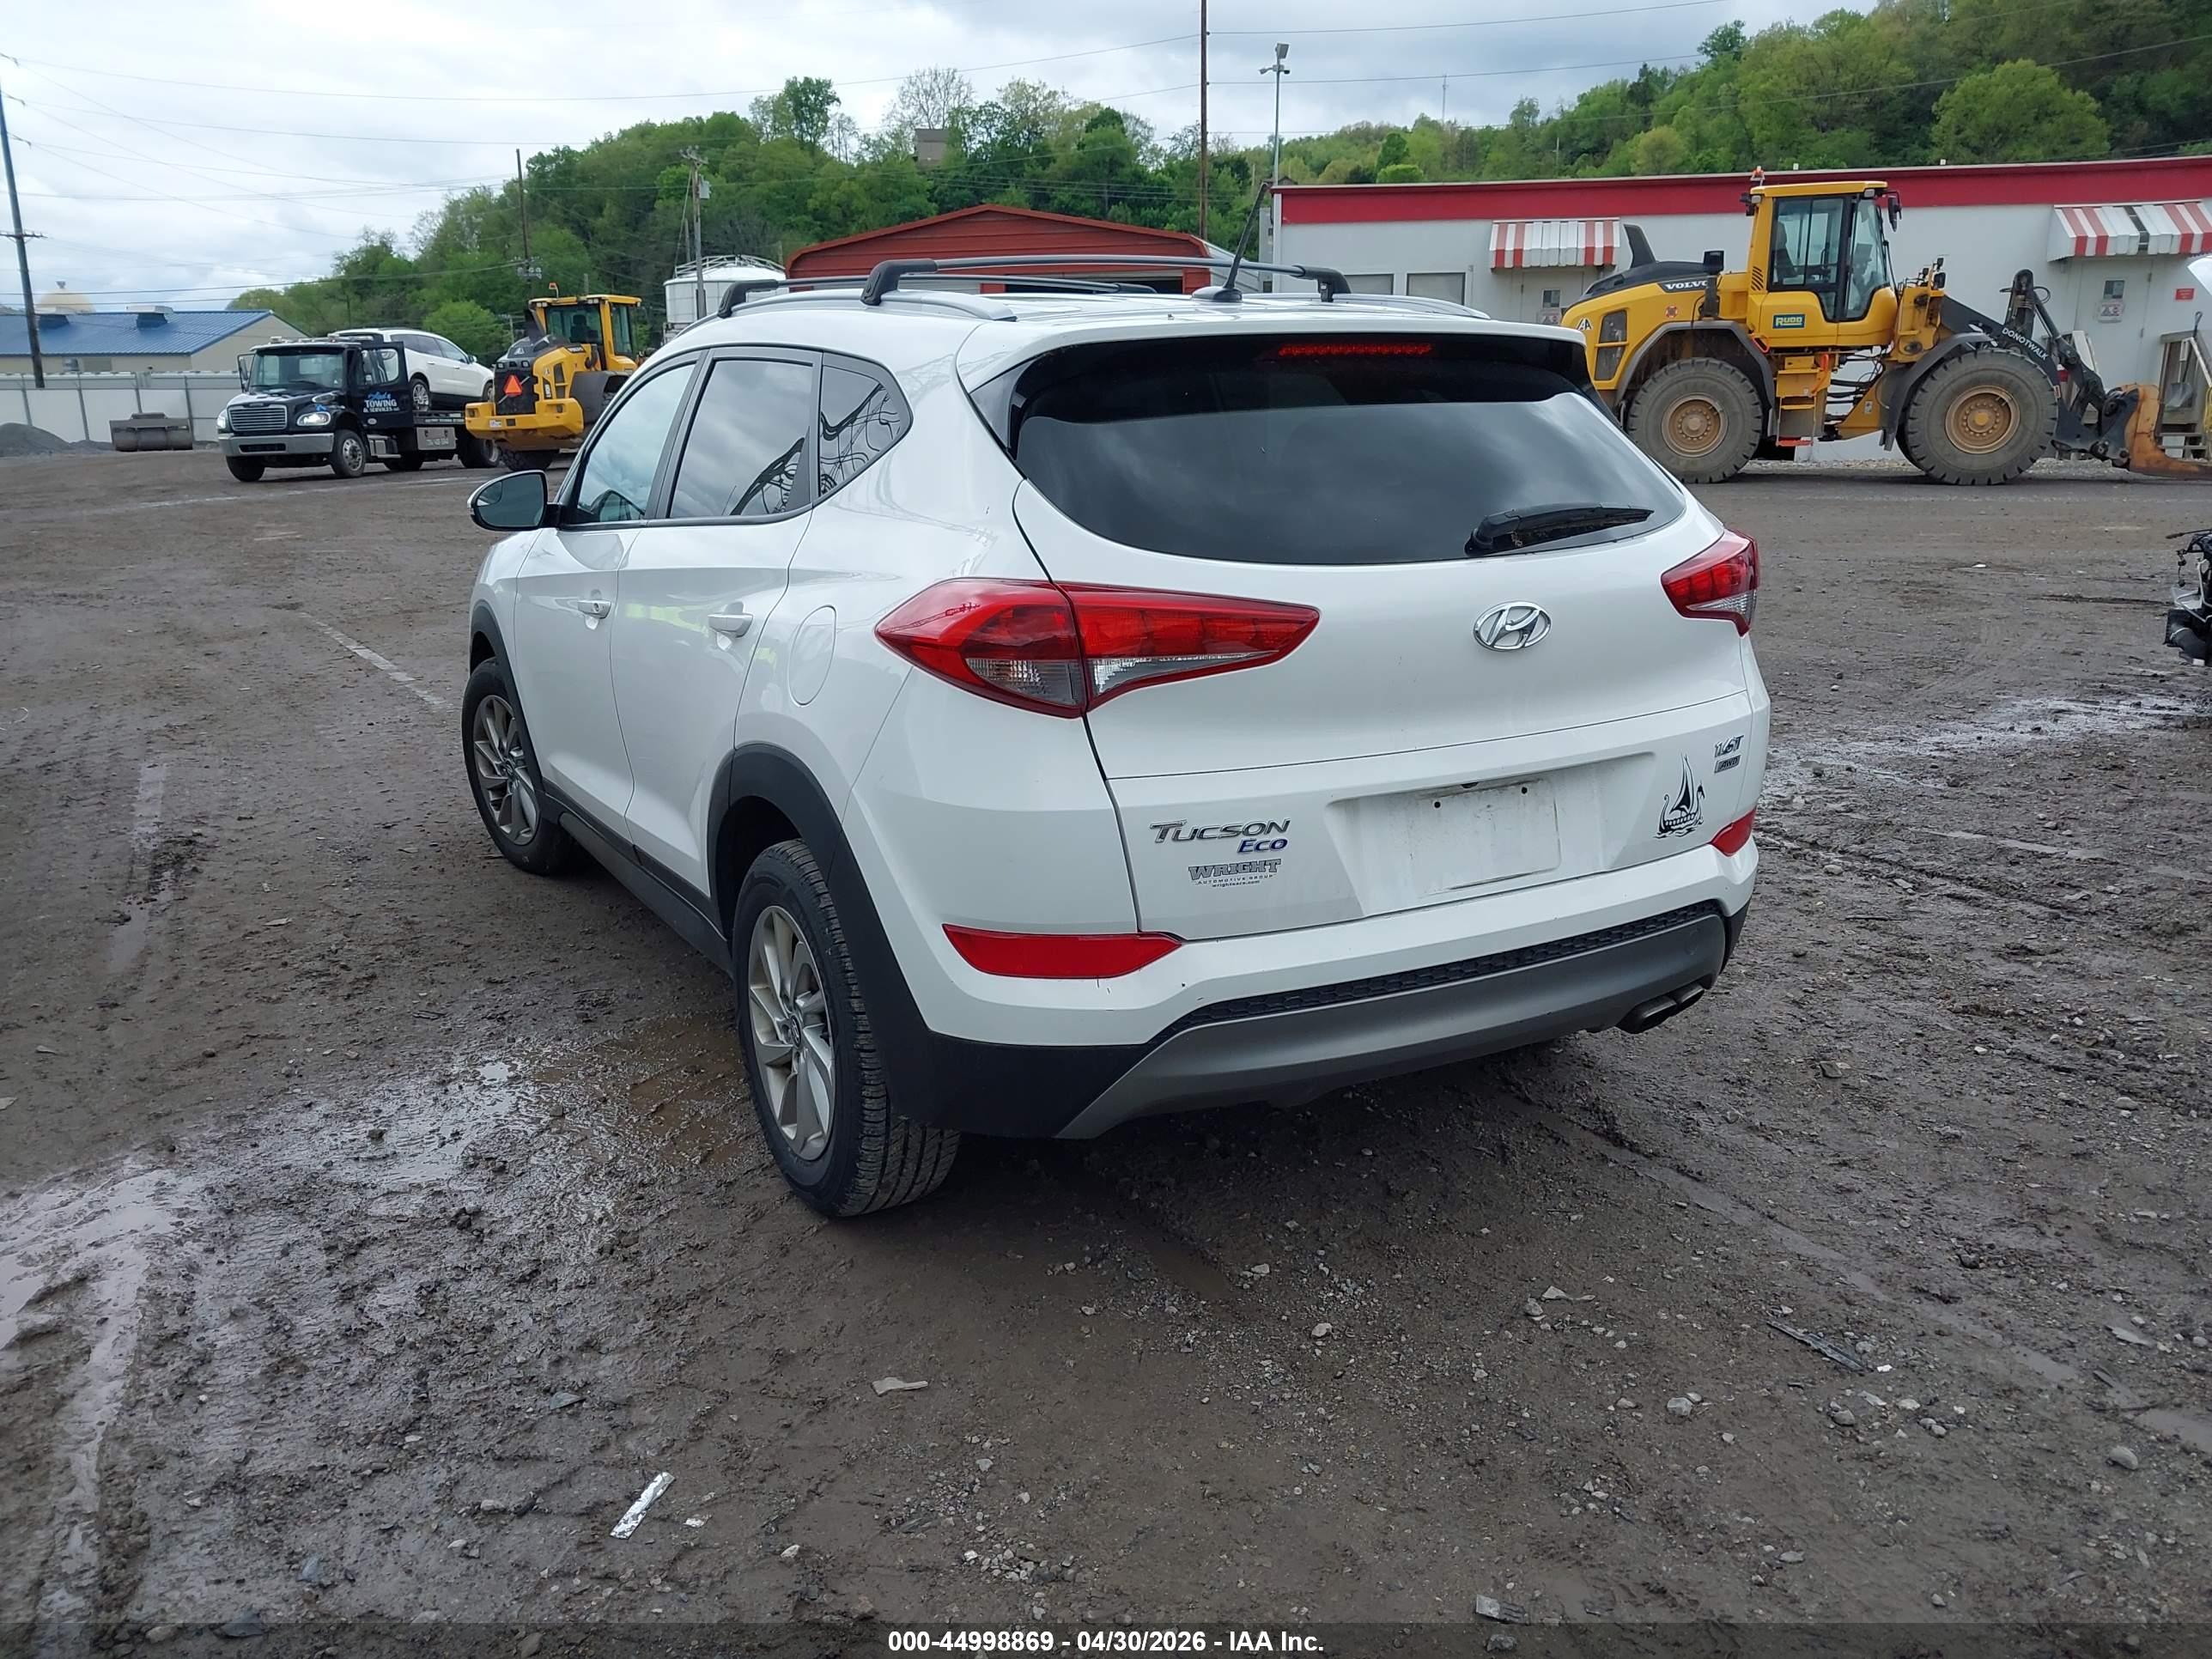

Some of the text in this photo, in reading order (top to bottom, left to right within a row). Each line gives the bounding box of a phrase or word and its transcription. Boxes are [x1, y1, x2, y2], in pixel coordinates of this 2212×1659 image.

[1775, 316, 1802, 326] RUDD
[364, 398, 398, 408] TOWING
[1720, 757, 1738, 770] AWD
[1188, 859, 1281, 880] WRIGHT
[1197, 877, 1246, 885] AUTOMOTIVE
